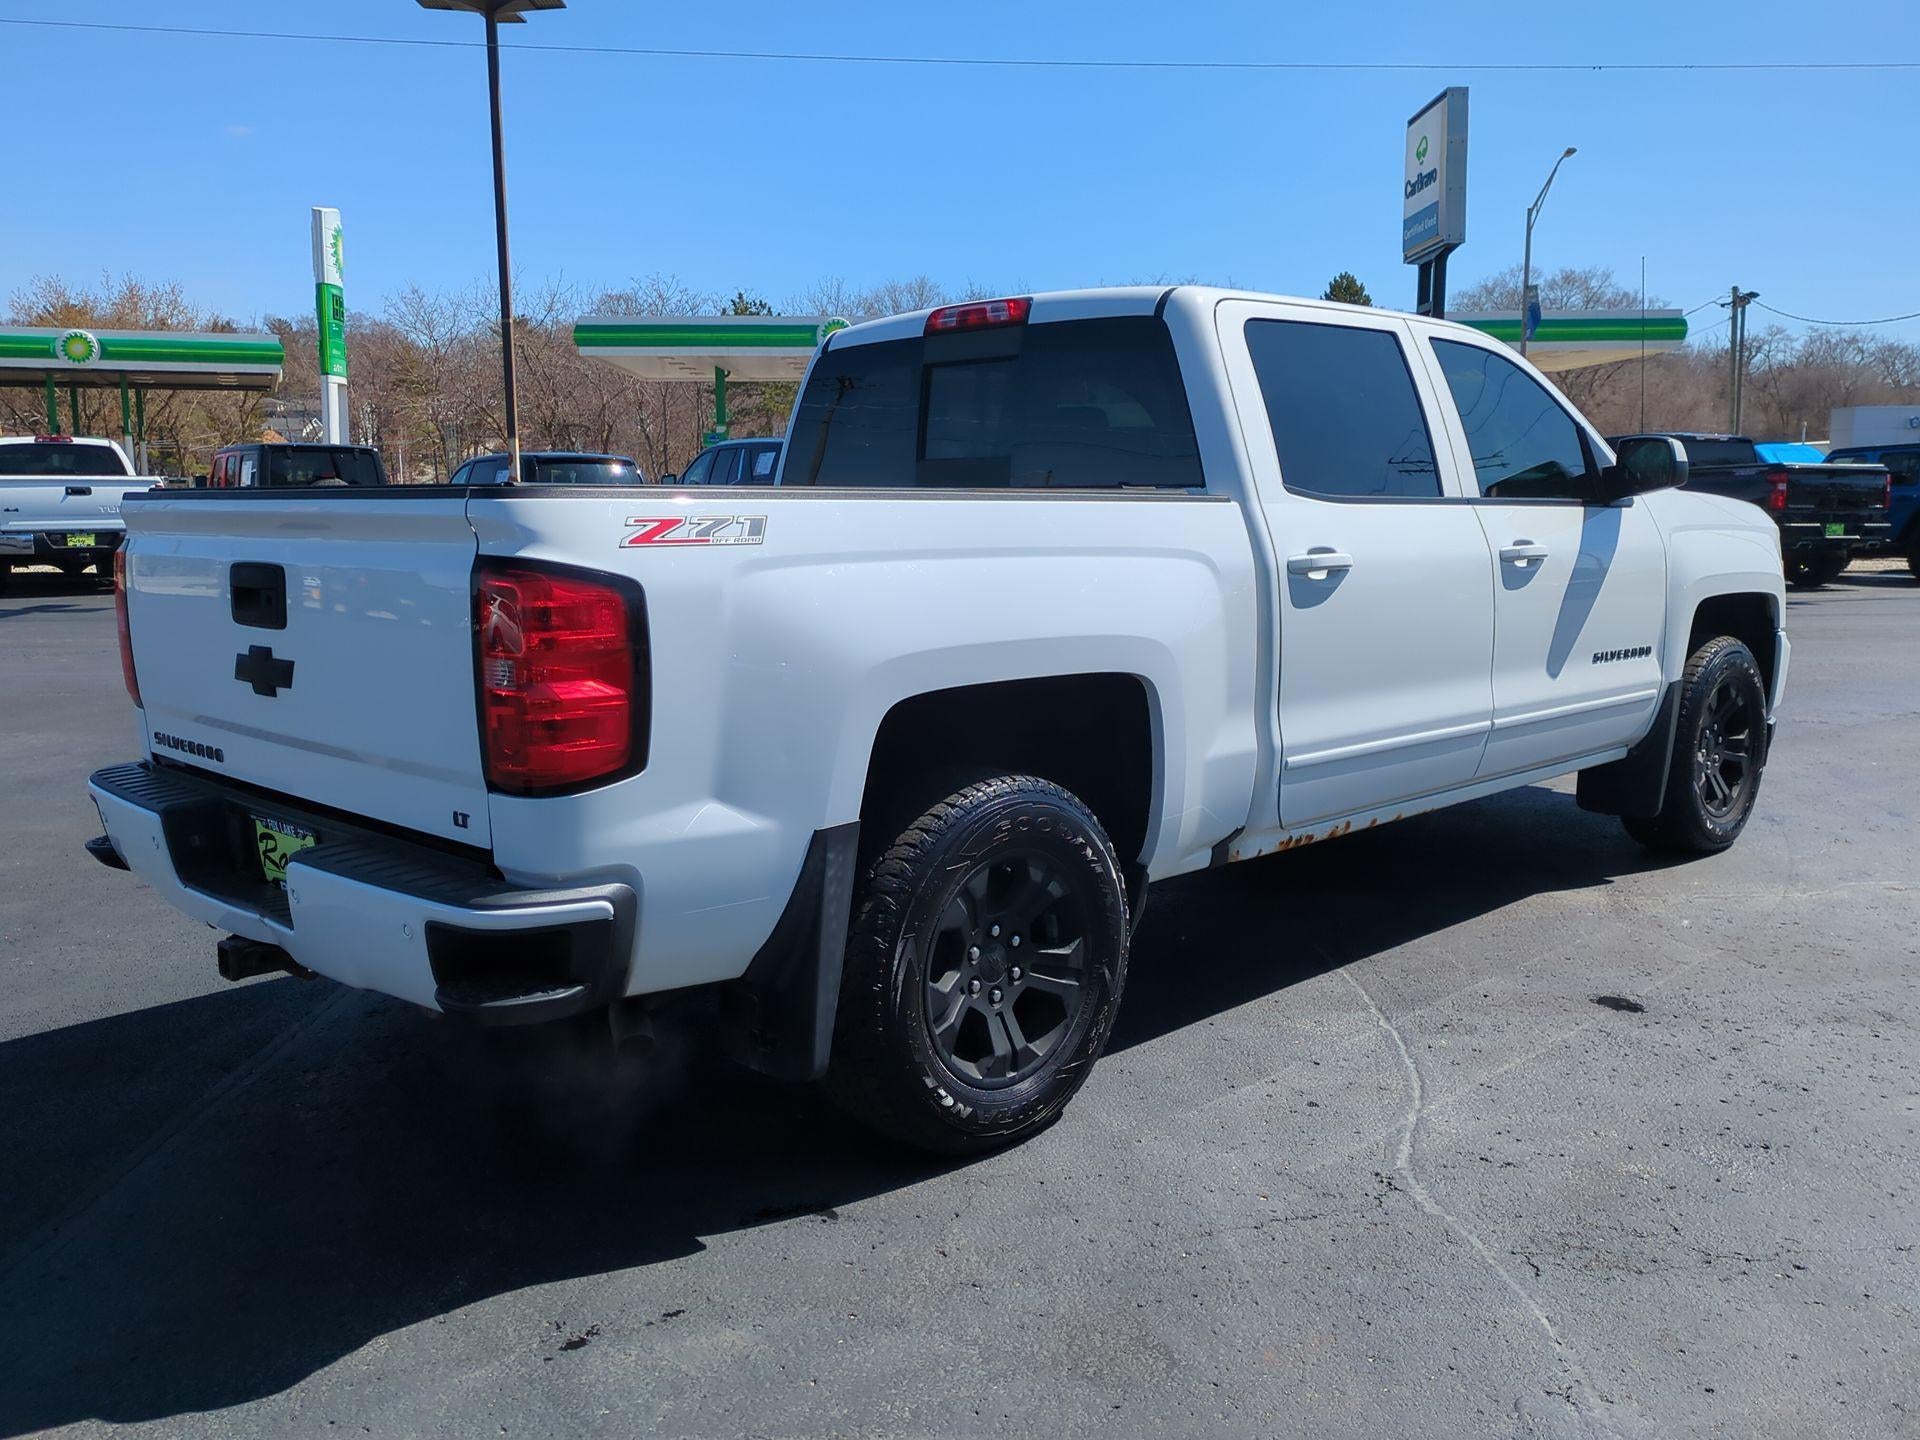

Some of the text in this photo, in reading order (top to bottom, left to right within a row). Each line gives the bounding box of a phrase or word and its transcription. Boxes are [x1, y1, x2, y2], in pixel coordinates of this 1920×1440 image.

[1404, 167, 1437, 199] CarBravo
[1404, 213, 1437, 240] Certified Used
[619, 515, 768, 548] Z71
[733, 536, 761, 544] ROAD
[1591, 645, 1652, 664] SILVERADO
[154, 731, 224, 763] SILVERADO
[453, 810, 470, 829] LT
